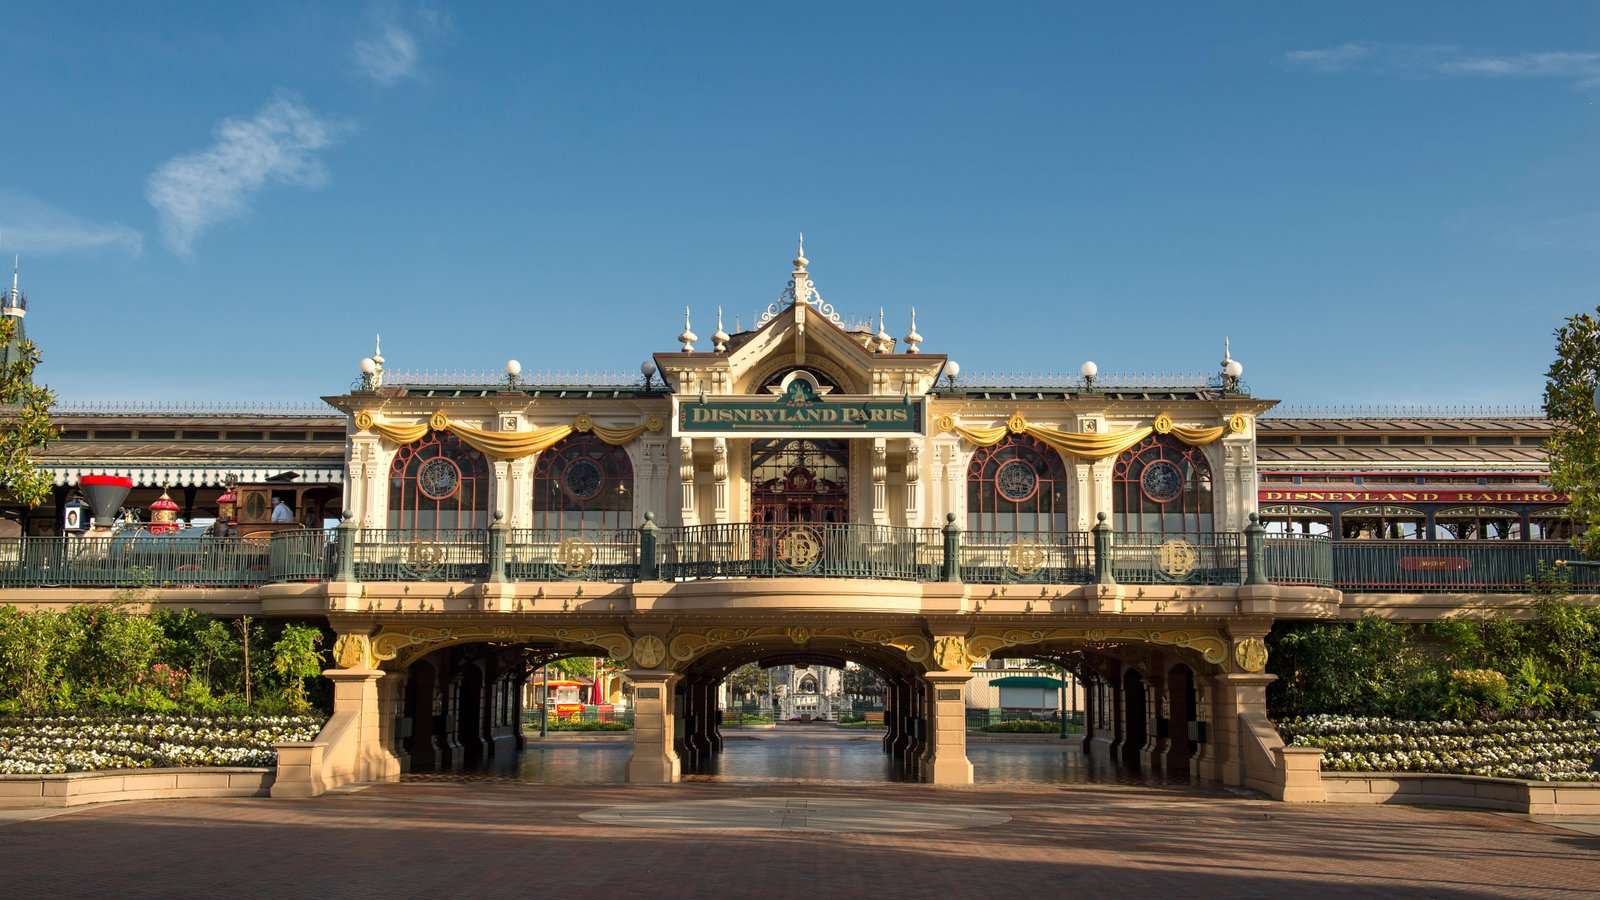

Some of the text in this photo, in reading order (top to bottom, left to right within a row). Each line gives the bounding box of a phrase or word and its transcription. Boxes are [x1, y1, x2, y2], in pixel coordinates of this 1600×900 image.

[692, 407, 908, 423] DISNEYLAND PARIS
[1266, 492, 1573, 501] DISNEYLAND RAILROA
